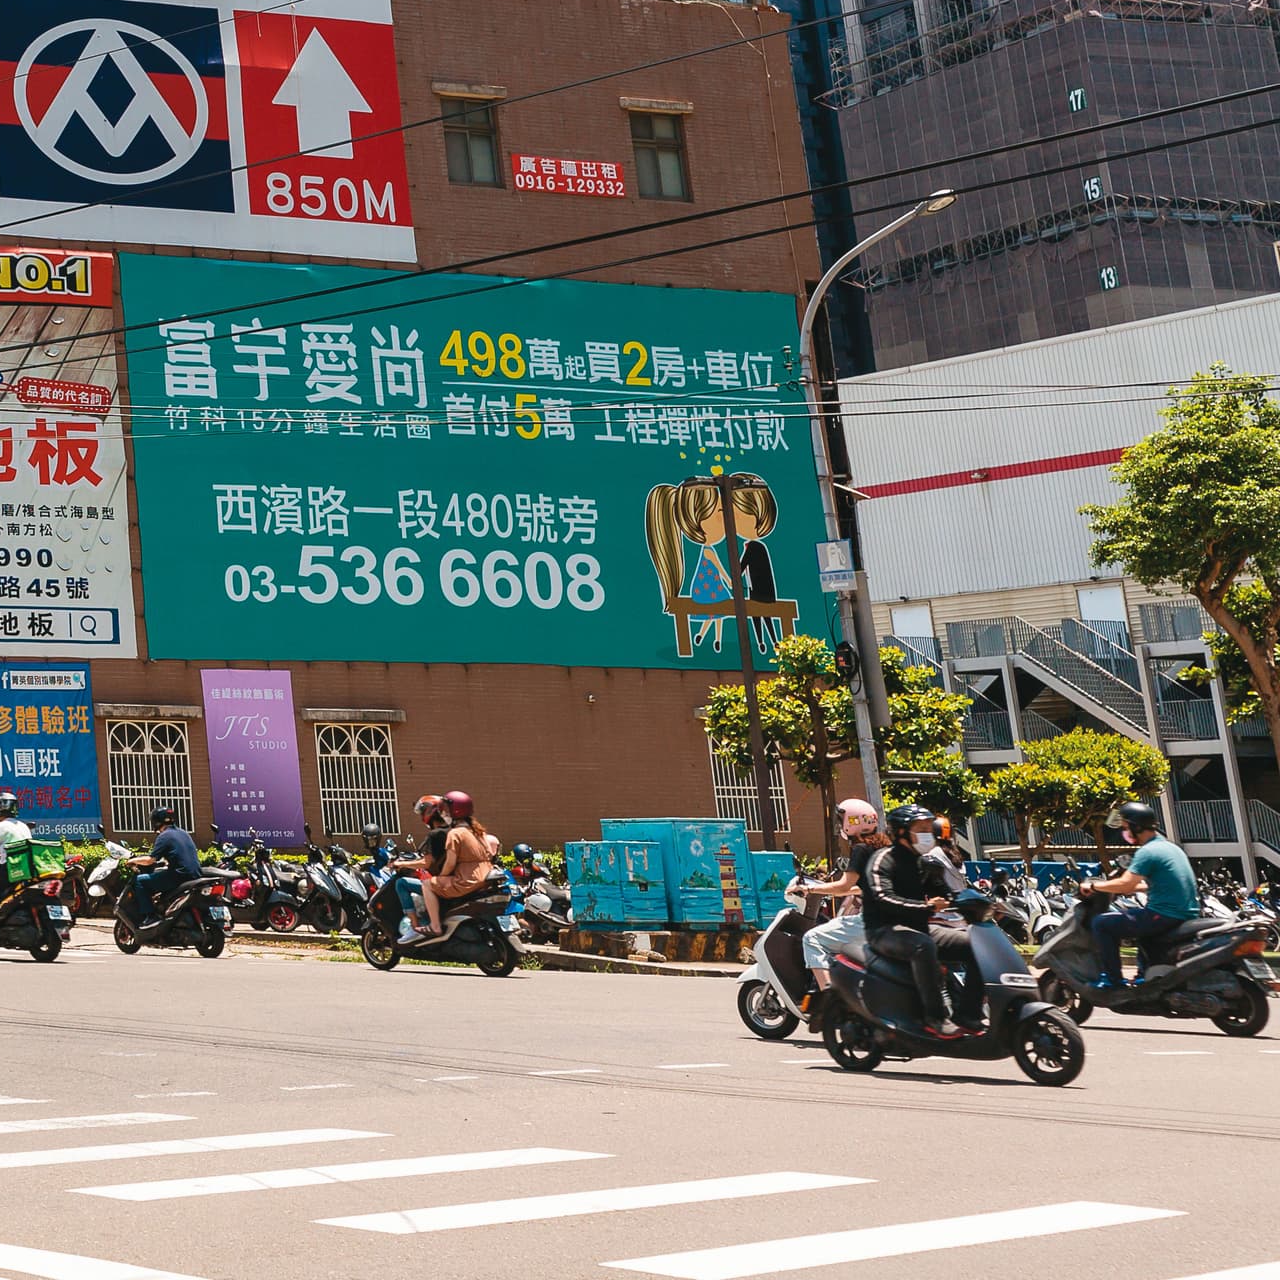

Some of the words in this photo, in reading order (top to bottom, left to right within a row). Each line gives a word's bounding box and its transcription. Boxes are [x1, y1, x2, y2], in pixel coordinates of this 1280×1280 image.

[515, 173, 625, 196] 0916-129332
[519, 156, 618, 180] 廣告牆出租
[266, 171, 396, 223] 850M
[158, 314, 429, 409] 富宇愛尚
[26, 384, 101, 406] 品質的代名詞
[443, 391, 576, 441] 首付5萬
[592, 401, 790, 452] 工程彈性付款
[212, 483, 599, 545] 西濱路一段480號旁
[224, 545, 425, 606] 03-536
[440, 548, 606, 611] 6608
[216, 713, 270, 740] JTS
[249, 740, 288, 750] STUDIO
